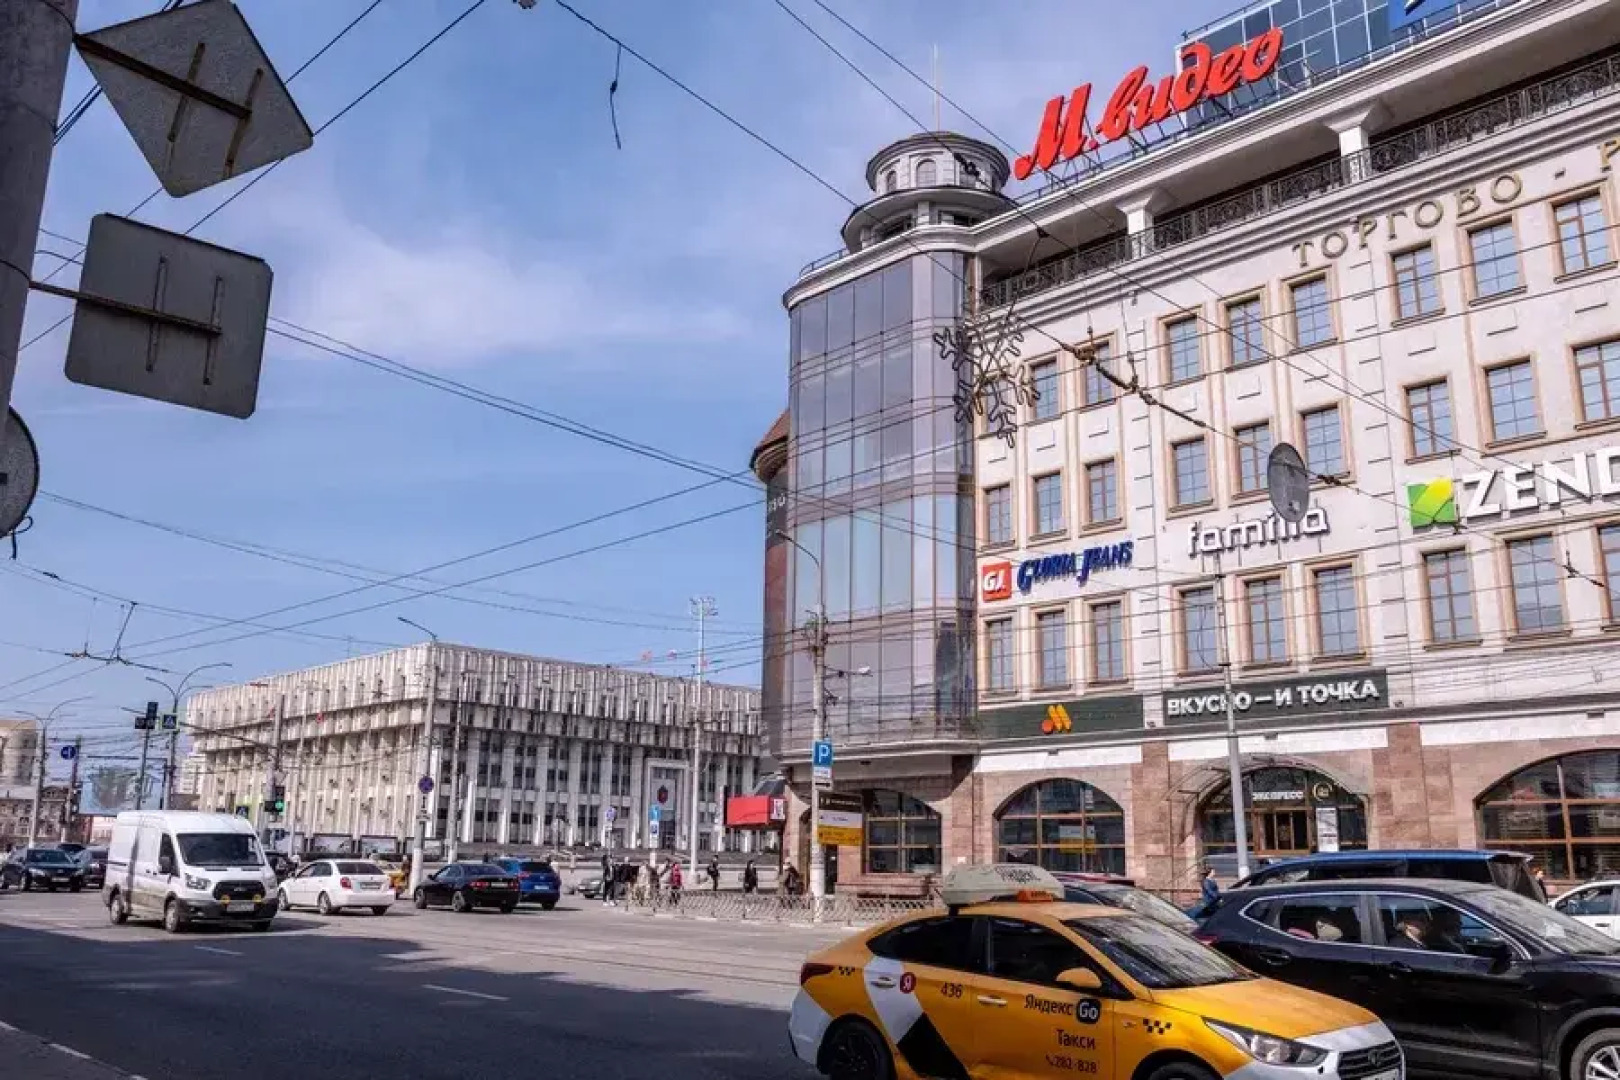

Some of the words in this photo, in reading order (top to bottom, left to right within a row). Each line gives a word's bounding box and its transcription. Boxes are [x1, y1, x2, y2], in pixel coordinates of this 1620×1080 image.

[1292, 172, 1523, 267] ТОРГОВО
[1167, 691, 1251, 716] ВКУСНО
[1297, 679, 1380, 704] ТОЧКА
[941, 982, 963, 998] 436
[1024, 993, 1073, 1016] Яндекс
[1079, 1001, 1099, 1020] Go
[1056, 1028, 1096, 1051] Такси
